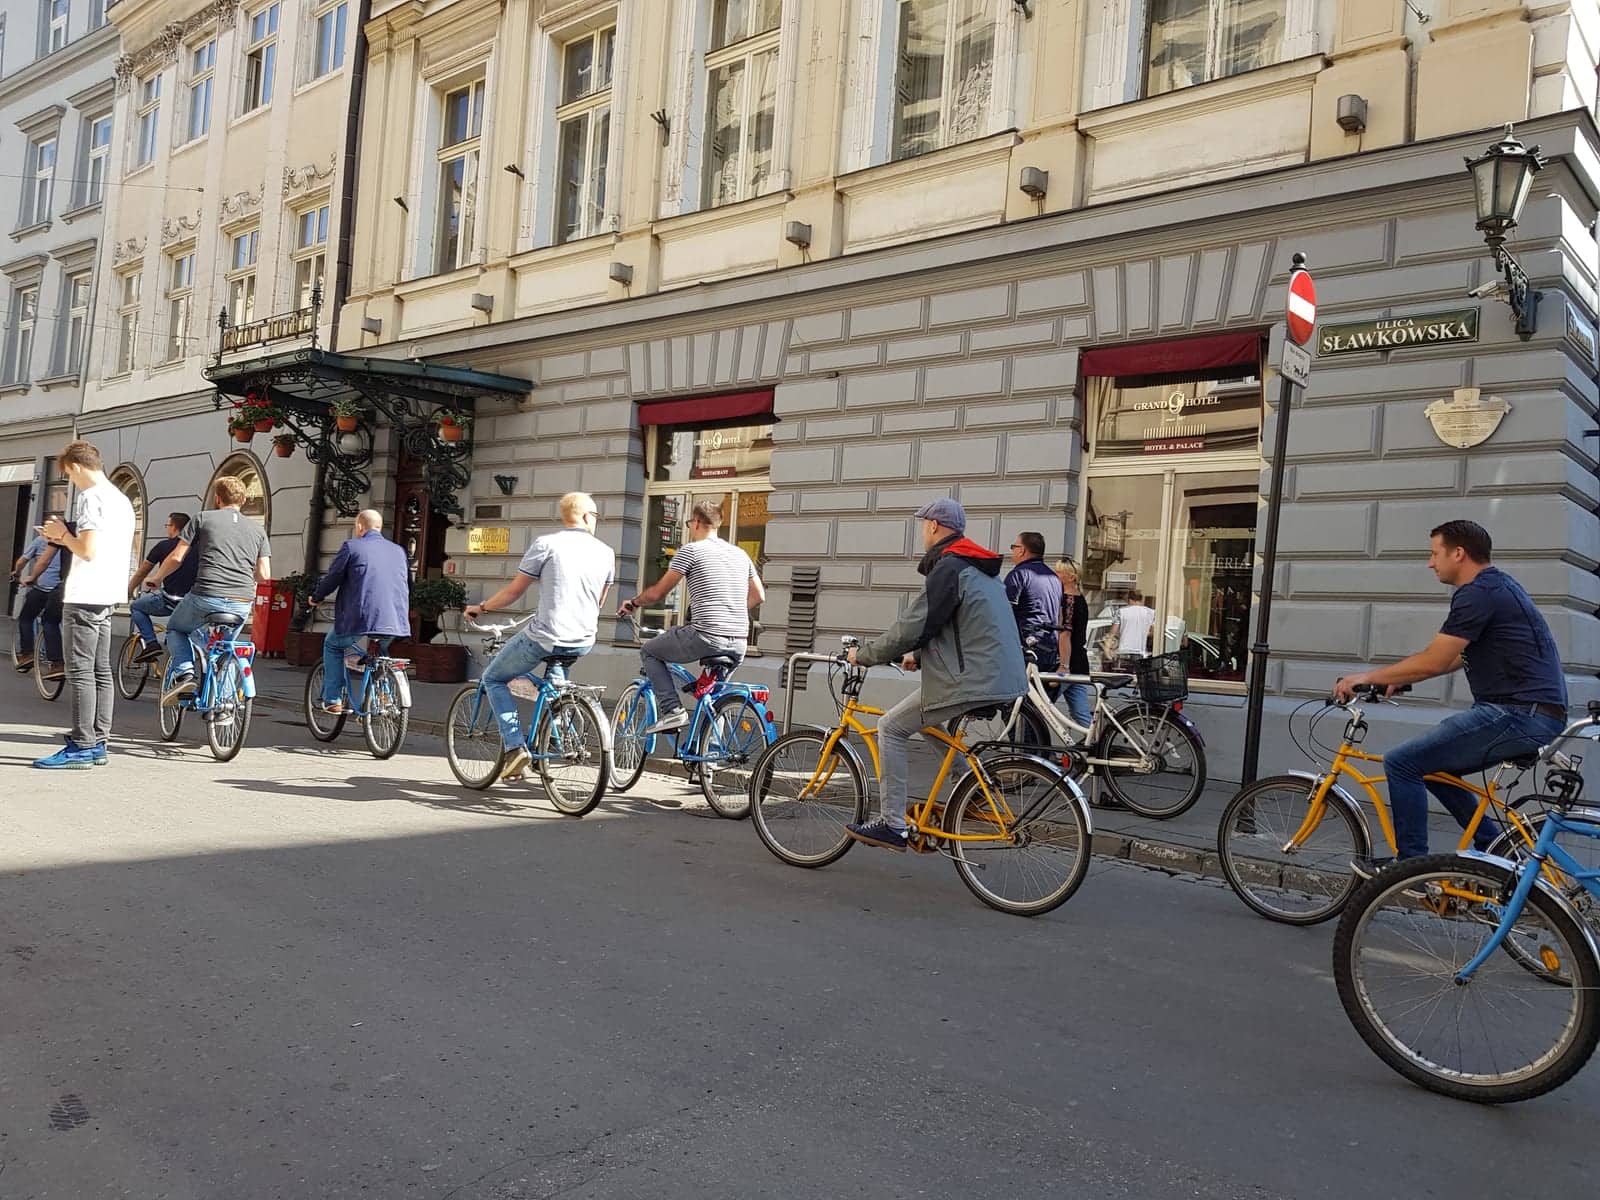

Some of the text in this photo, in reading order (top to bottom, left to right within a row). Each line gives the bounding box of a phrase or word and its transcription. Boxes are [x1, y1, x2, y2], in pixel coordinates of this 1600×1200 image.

[1376, 319, 1415, 330] ULICA
[1322, 322, 1471, 352] SŁAWKOWSKA
[1134, 401, 1167, 410] GRAND
[1186, 396, 1221, 407] HOTEL
[1176, 442, 1204, 450] PALACE
